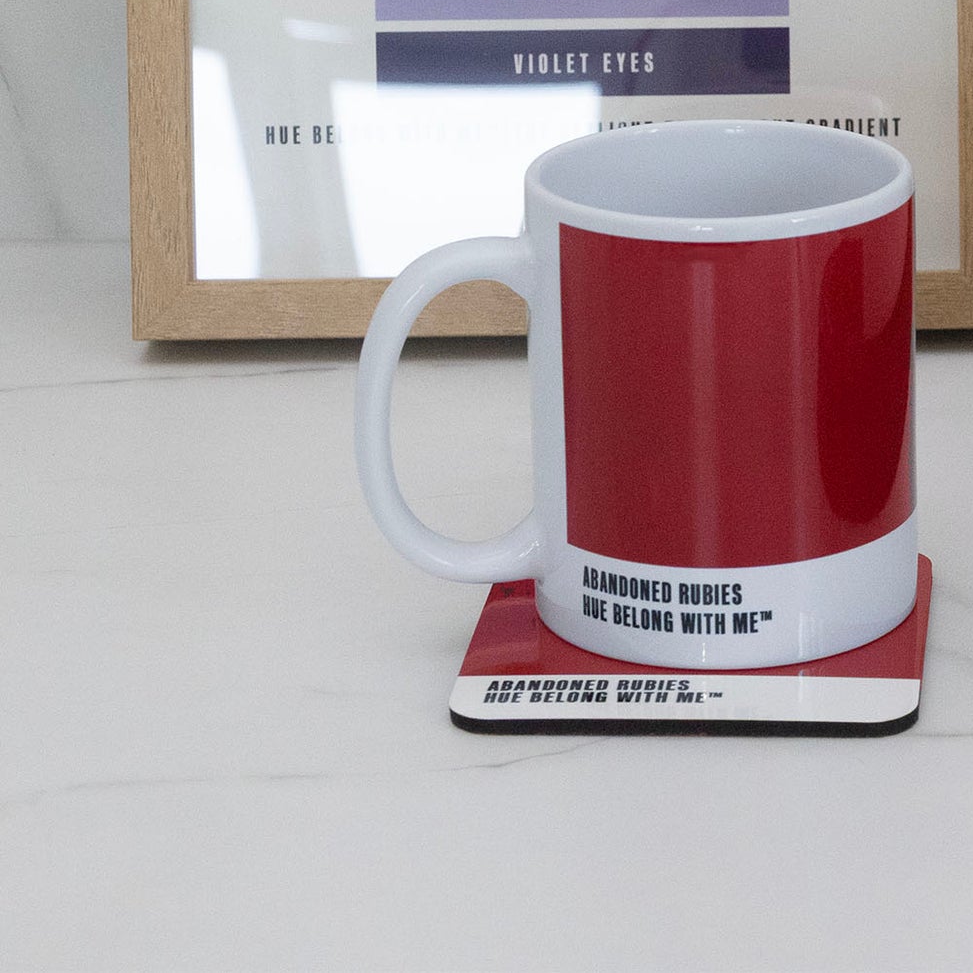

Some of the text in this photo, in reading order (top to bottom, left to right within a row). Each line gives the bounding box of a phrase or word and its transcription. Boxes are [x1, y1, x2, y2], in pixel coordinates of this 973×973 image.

[513, 51, 655, 75] VIOLET EYES
[265, 125, 301, 145] HUE
[582, 565, 743, 606] ABANDONED RUBIES
[582, 593, 608, 623] HUE
[612, 602, 674, 633] BELONG
[680, 611, 726, 635] WITH
[487, 679, 691, 692] ABANDONED RUBIES
[483, 691, 523, 704] HUE
[529, 691, 608, 704] BELONG
[616, 691, 668, 704] WITH
